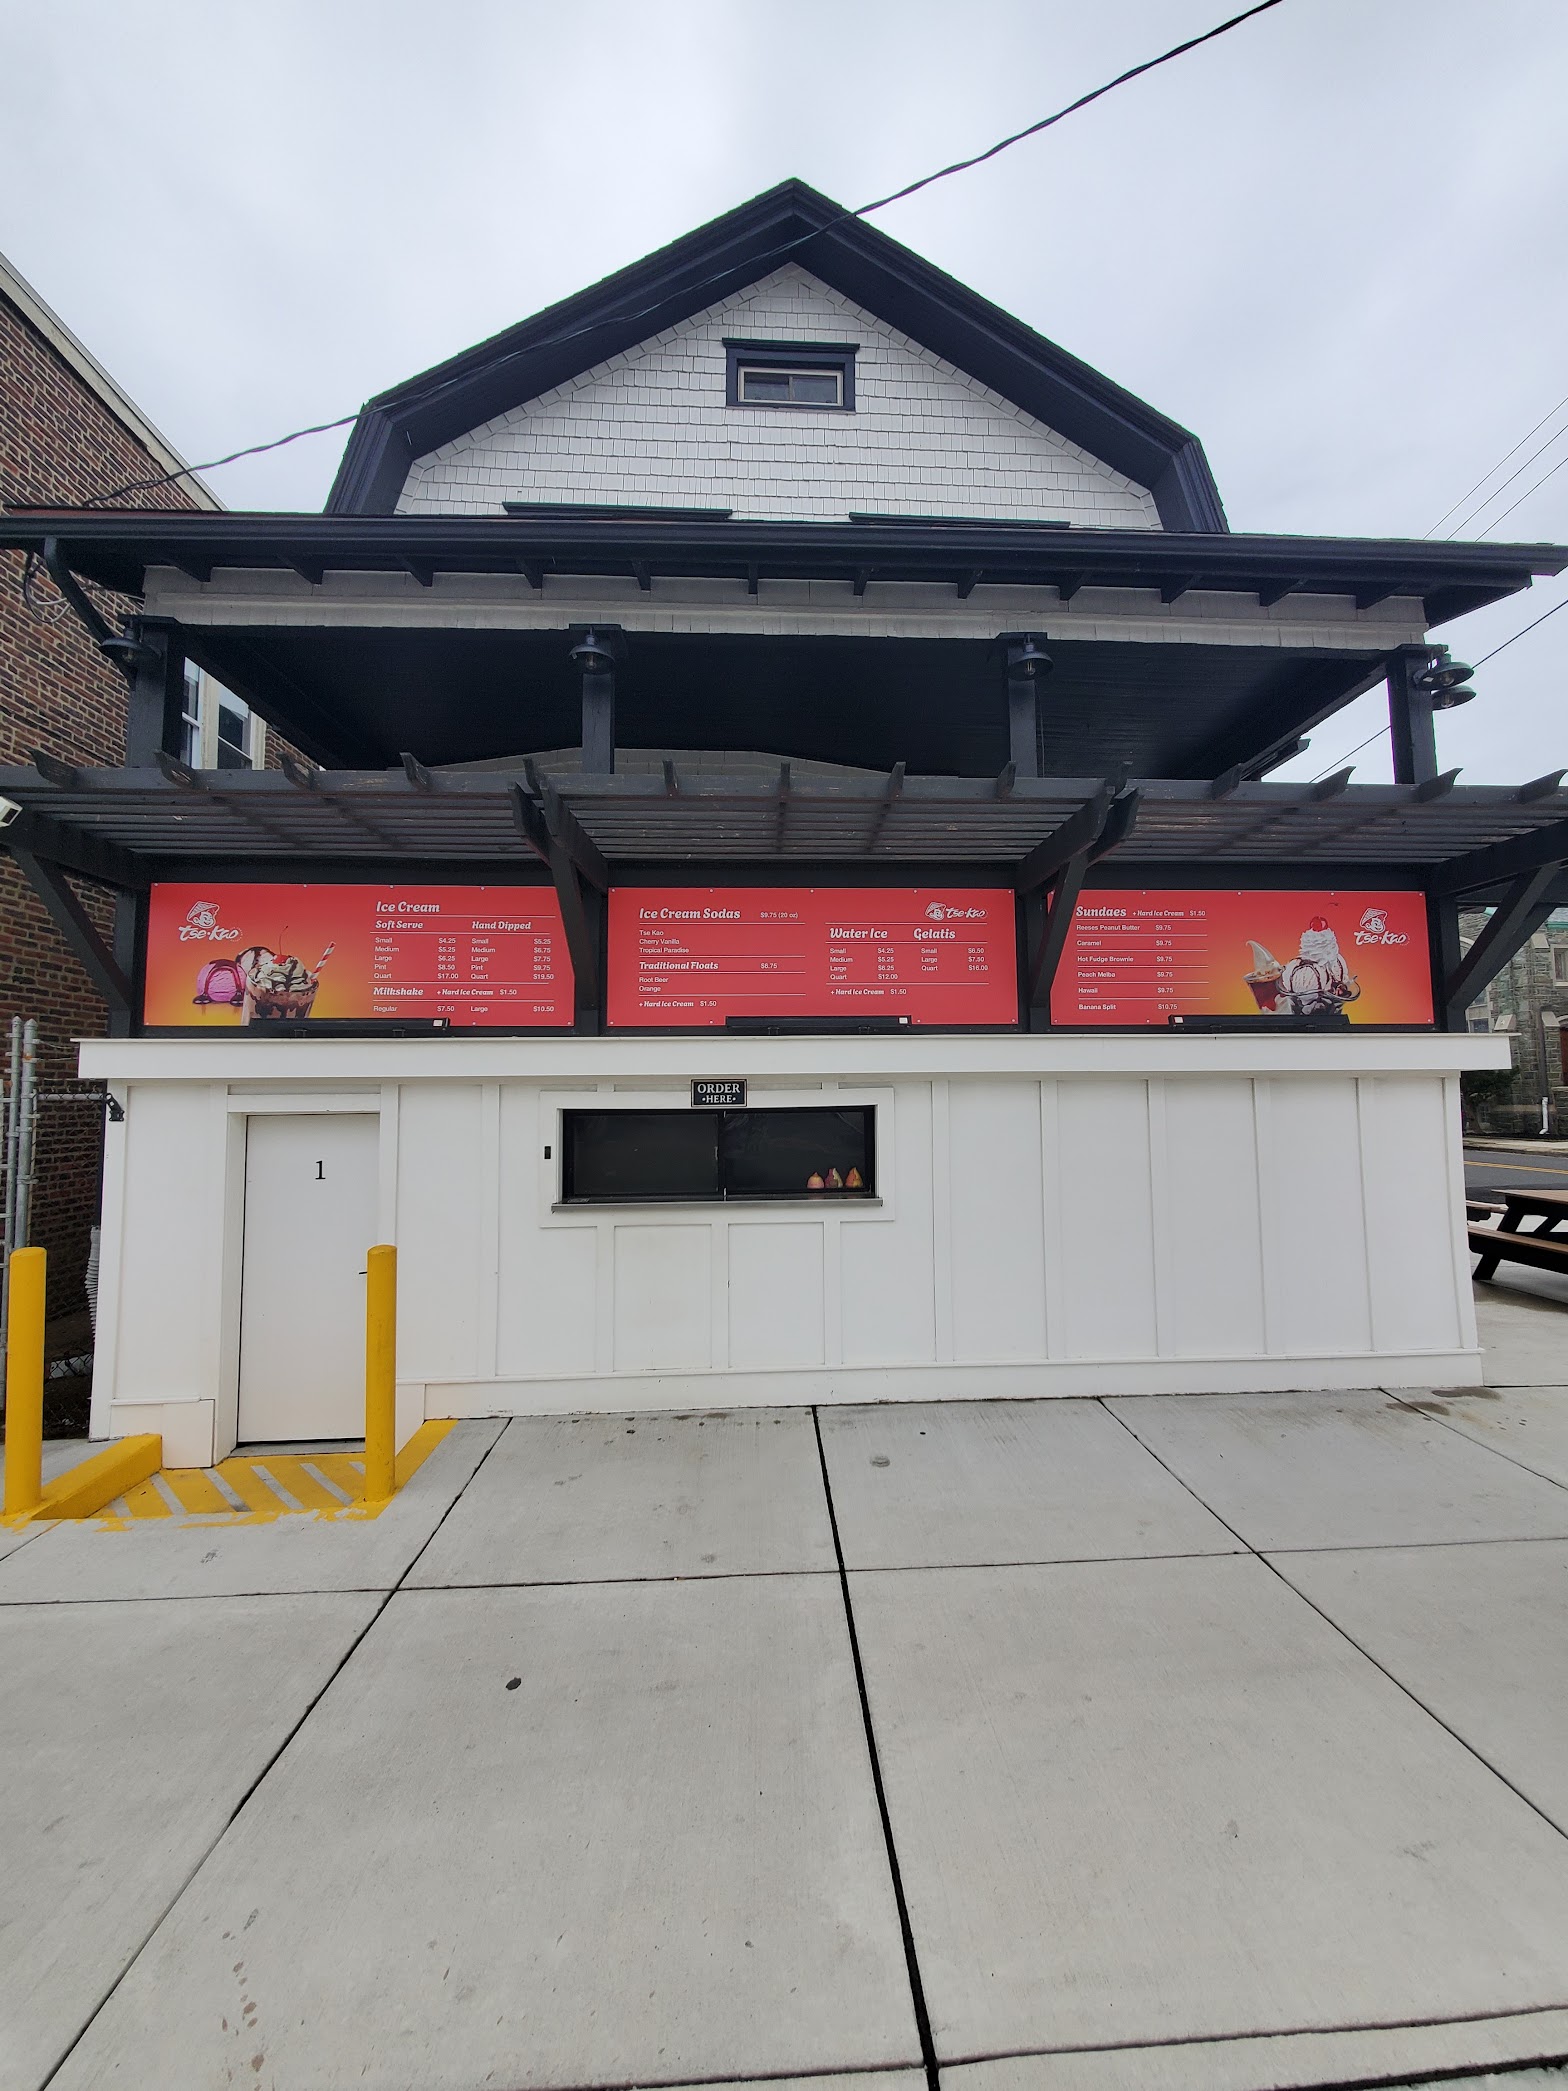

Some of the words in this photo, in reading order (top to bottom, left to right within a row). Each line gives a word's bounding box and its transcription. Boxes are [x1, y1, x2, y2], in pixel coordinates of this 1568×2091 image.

[376, 901, 395, 912] Ice
[397, 901, 440, 913] Cream
[1076, 906, 1127, 917] Sundaes
[639, 908, 658, 919] Ice
[659, 908, 702, 919] Cream
[703, 908, 741, 919] Sodas
[375, 921, 396, 929] Soft
[396, 921, 423, 929] Serve
[472, 921, 496, 929] Hand
[497, 922, 531, 931] Dipped
[830, 928, 868, 939] Water
[870, 928, 888, 939] Ice
[913, 928, 956, 940] Gelatis
[639, 961, 690, 970] Traditional
[691, 961, 719, 970] Floats
[373, 987, 423, 996] Milkshake
[697, 1083, 741, 1094] ORDER
[315, 1160, 326, 1180] 1
